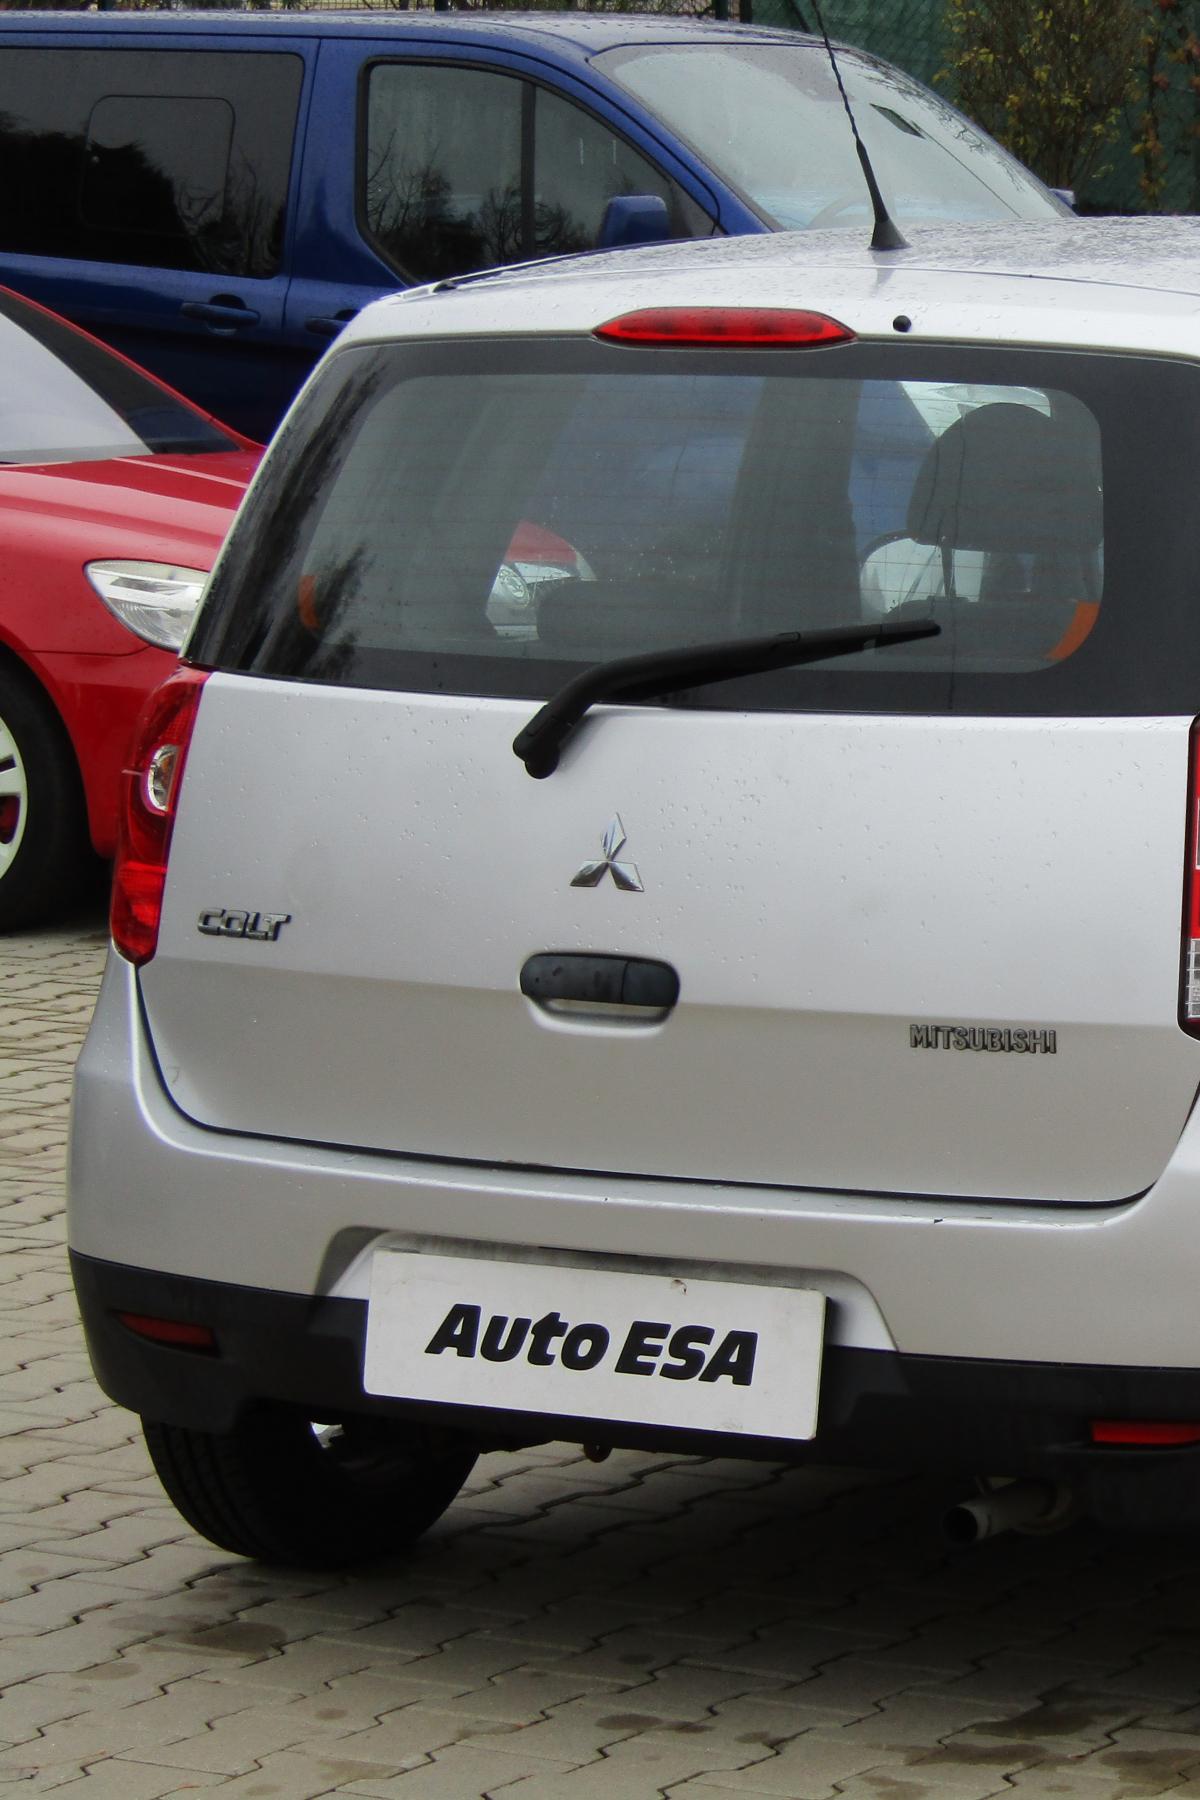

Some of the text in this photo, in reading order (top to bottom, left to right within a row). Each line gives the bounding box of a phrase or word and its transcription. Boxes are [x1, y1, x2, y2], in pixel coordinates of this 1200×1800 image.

[198, 908, 292, 941] COLT
[909, 1024, 1057, 1054] MITSUBISHI
[424, 1303, 758, 1386] Auto ESA
